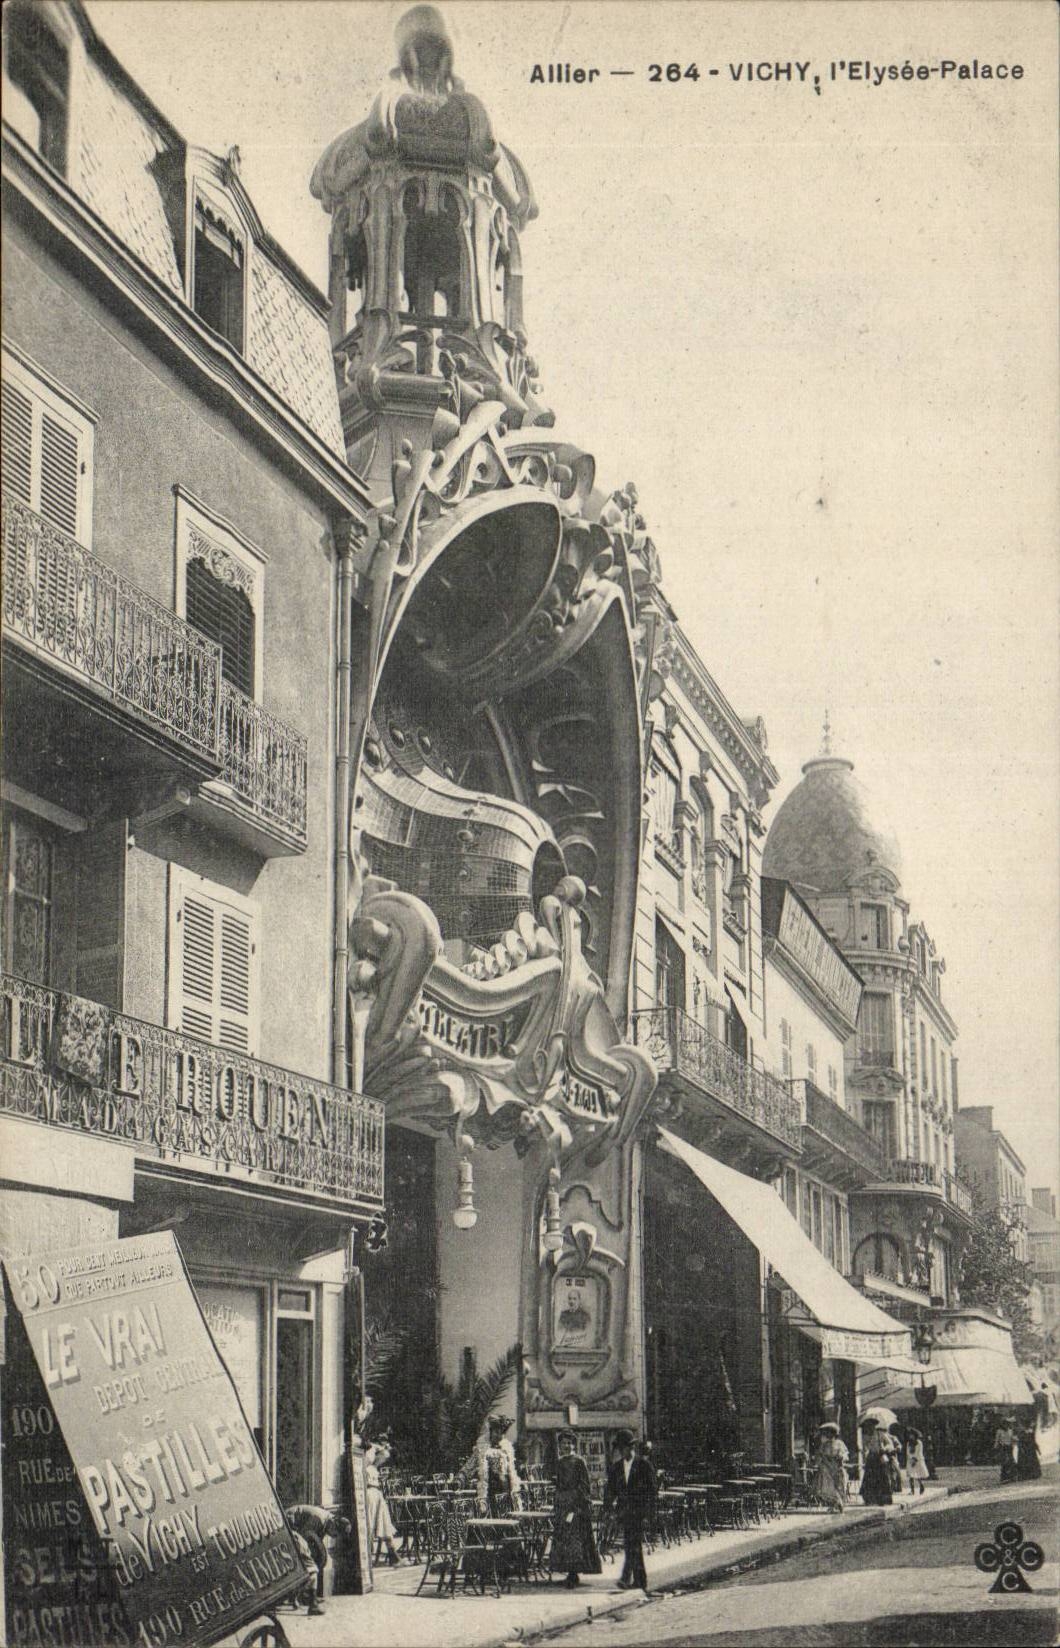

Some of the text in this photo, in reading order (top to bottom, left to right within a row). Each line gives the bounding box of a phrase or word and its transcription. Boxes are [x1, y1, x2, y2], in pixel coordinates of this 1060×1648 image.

[172, 1050, 331, 1150] ROUEN
[13, 1263, 60, 1310] 50
[42, 1302, 167, 1390] LE VRAI
[12, 1406, 54, 1437] 190
[18, 1458, 55, 1485] RUE
[82, 1415, 257, 1535] PASTILLES
[128, 1505, 204, 1572] VICHY
[207, 1502, 284, 1560] TOUJOURS
[189, 1587, 231, 1625] RUE
